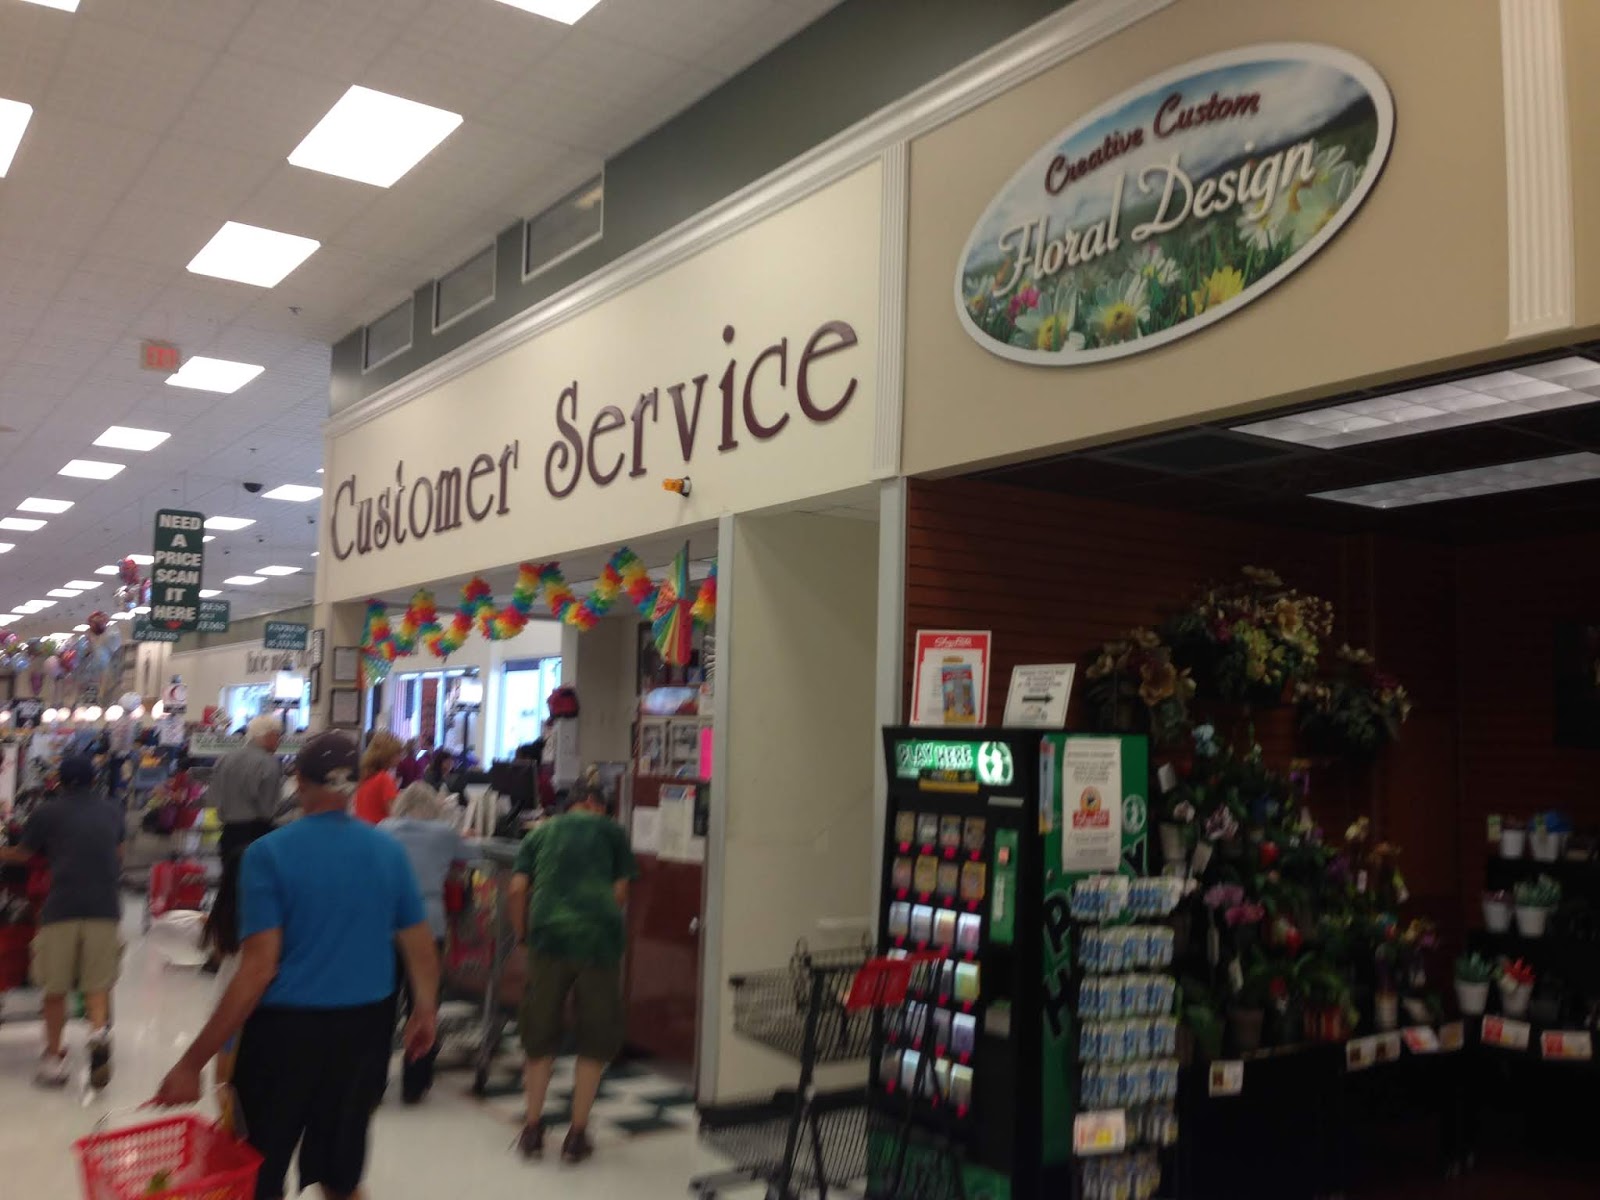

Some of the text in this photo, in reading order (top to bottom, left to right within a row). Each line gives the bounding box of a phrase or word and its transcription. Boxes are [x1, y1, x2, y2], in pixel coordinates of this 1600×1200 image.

[1044, 92, 1261, 195] Creative Custom
[993, 141, 1315, 297] Floral Design
[331, 319, 857, 561] Customer Service
[159, 514, 202, 531] NEED
[171, 534, 187, 547] A
[153, 550, 202, 568] PRICE
[156, 569, 200, 586] SCAN
[165, 588, 186, 602] IT
[153, 604, 198, 621] HERE
